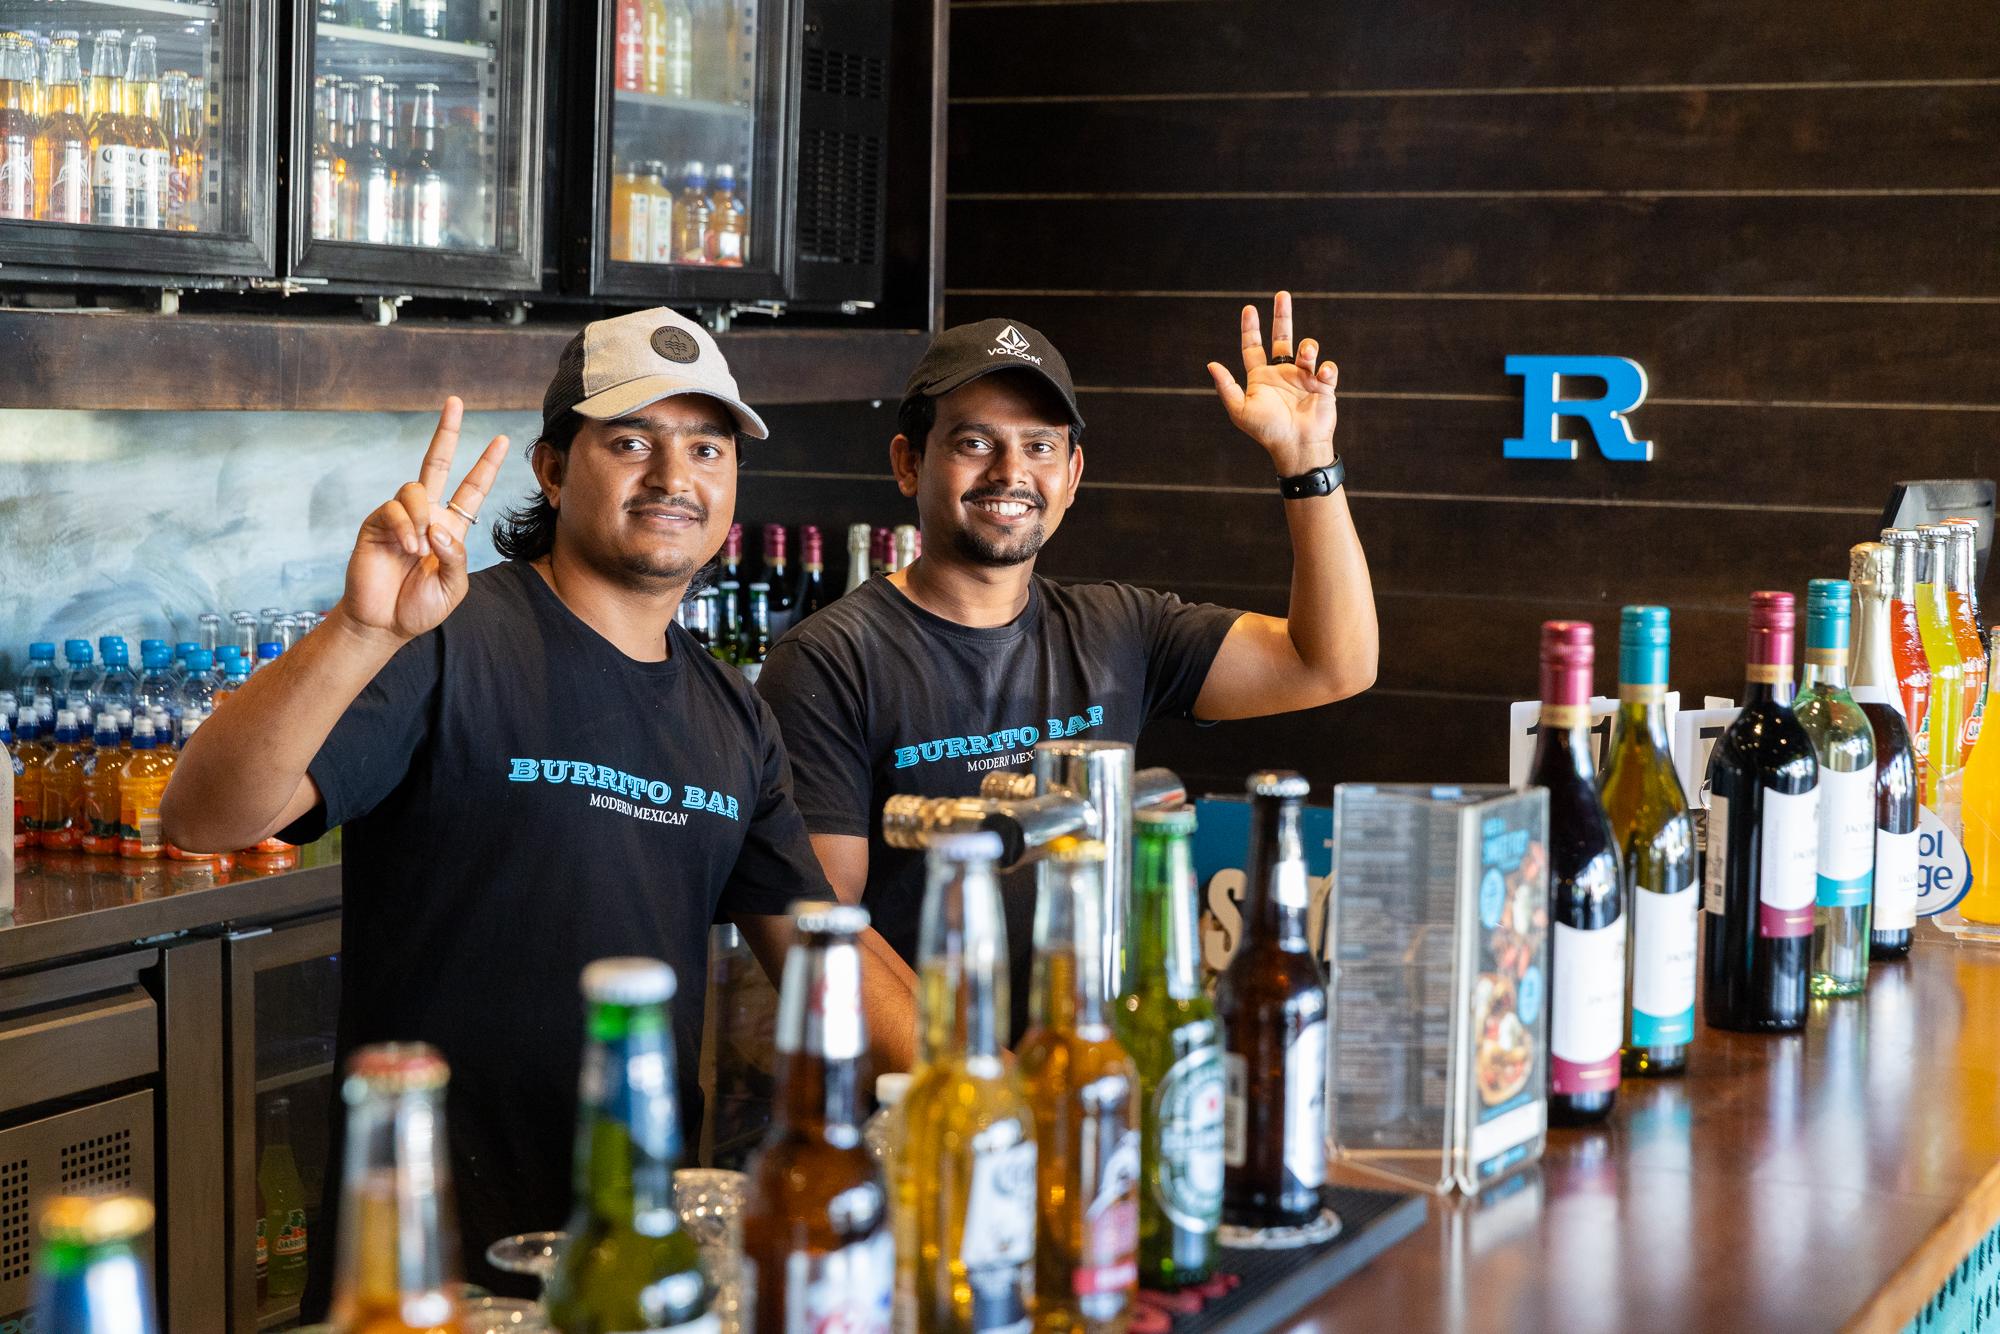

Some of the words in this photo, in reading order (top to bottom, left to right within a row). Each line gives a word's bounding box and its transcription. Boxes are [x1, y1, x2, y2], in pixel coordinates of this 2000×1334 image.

[987, 347, 1042, 366] VOLCOM
[1503, 355, 1653, 461] R
[894, 726, 1040, 769] BURRITO
[1047, 705, 1104, 739] BAR
[967, 755, 1010, 773] MODERN
[1011, 748, 1036, 765] MEX
[508, 757, 672, 805] BURRITO
[682, 785, 740, 822] BAR
[589, 793, 633, 817] MODERN
[633, 807, 689, 826] MEXICAN
[1919, 829, 1943, 858] ol
[1917, 863, 1953, 898] ge
